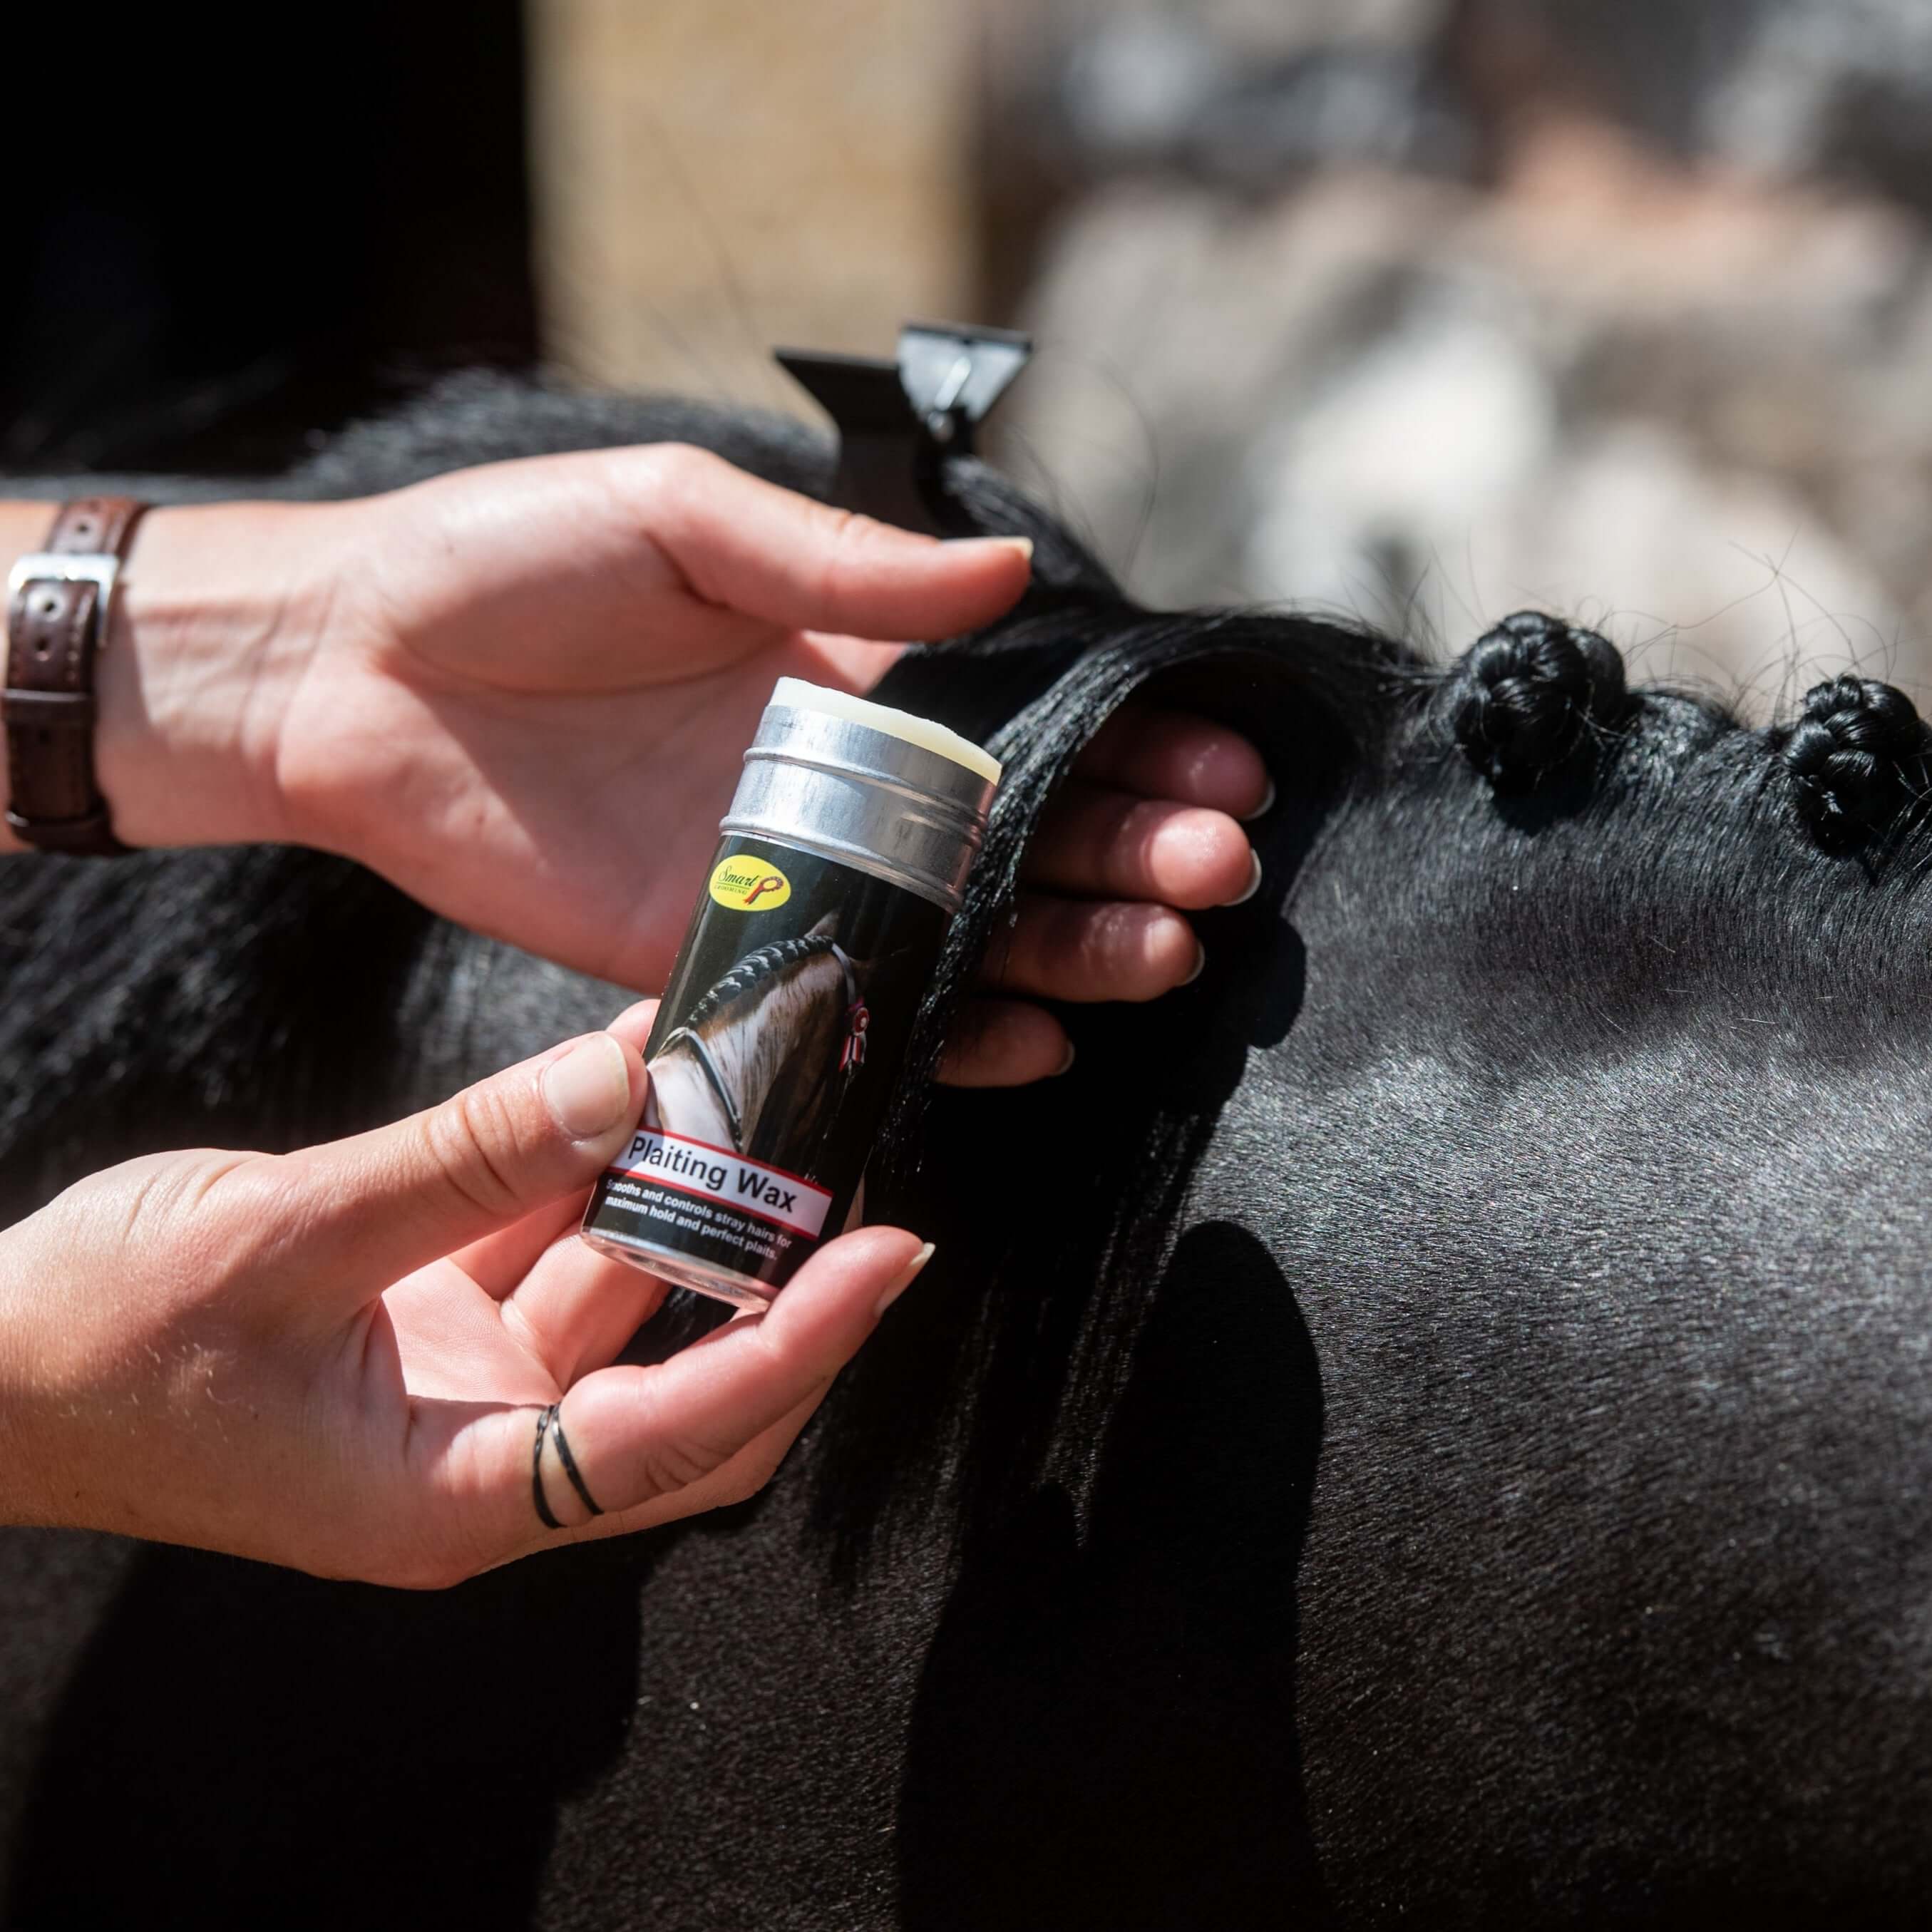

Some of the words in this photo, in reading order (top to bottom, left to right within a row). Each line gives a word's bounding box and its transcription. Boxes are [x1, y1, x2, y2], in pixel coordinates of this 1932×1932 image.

[718, 865, 759, 887] Smart
[628, 1136, 727, 1190] Plaiting
[736, 1168, 797, 1213] Wax
[605, 1196, 648, 1215] maximum
[649, 1206, 675, 1223] hold
[677, 1215, 700, 1231] and
[701, 1223, 744, 1246] perfect
[744, 1239, 778, 1260] plaits.
[642, 1186, 664, 1203] and
[664, 1195, 712, 1218] controls
[714, 1211, 745, 1231] stray
[746, 1223, 775, 1242] hairs
[776, 1233, 792, 1248] for
